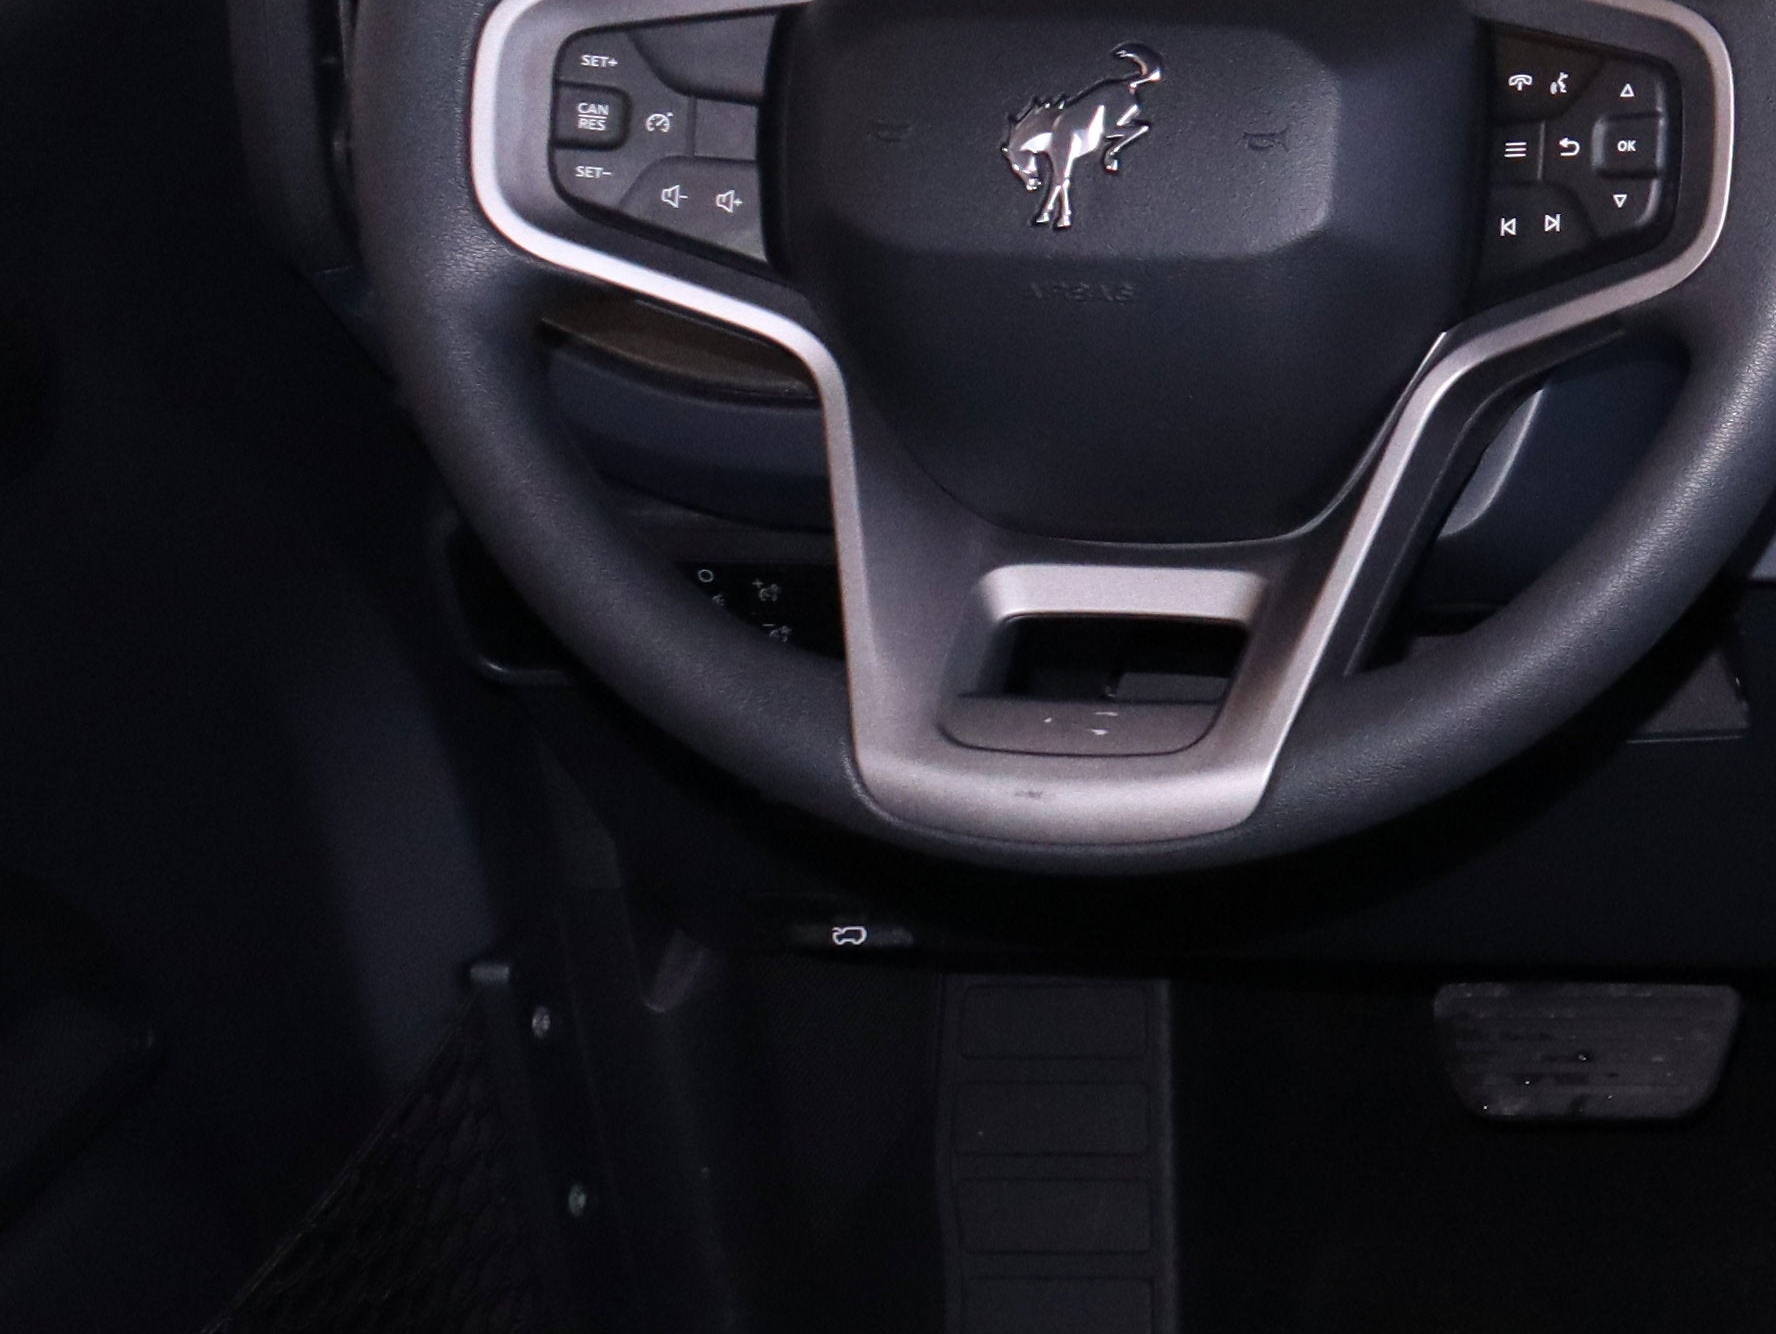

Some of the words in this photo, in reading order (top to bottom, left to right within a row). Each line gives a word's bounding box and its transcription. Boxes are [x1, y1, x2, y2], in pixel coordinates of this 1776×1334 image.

[581, 54, 618, 67] SET+
[577, 102, 609, 116] CAN
[577, 118, 606, 131] RES
[1616, 138, 1637, 153] OK
